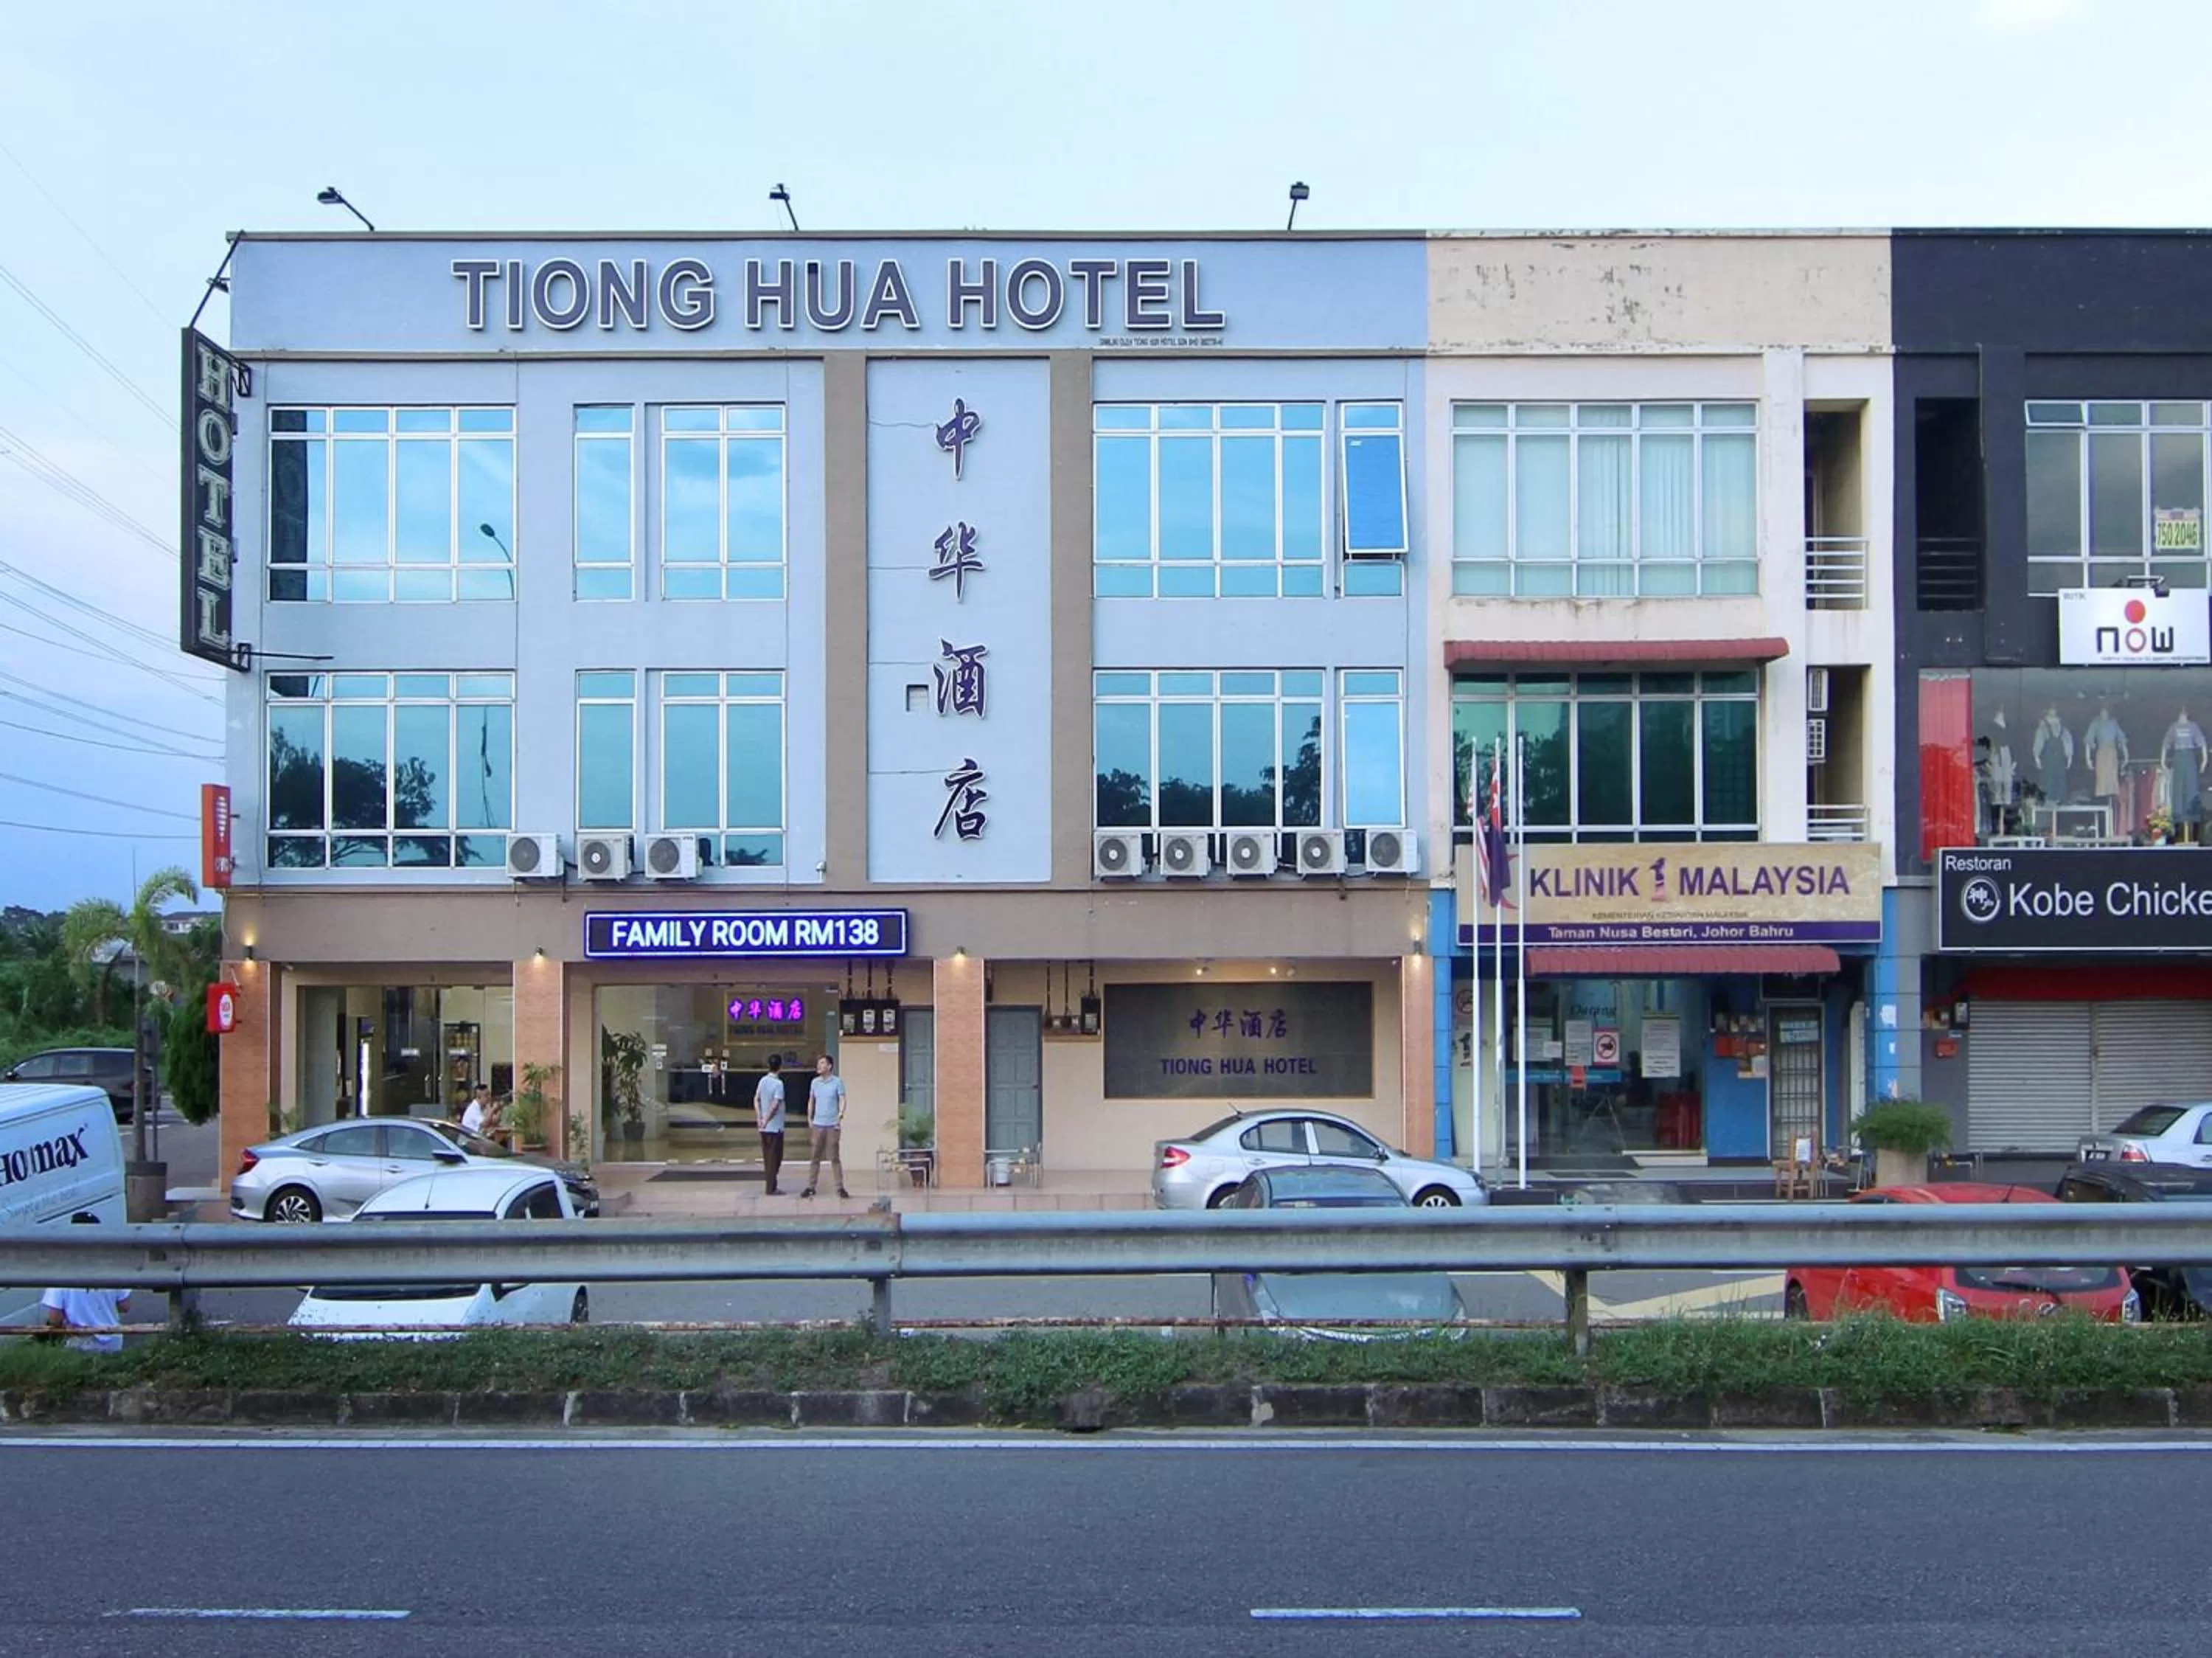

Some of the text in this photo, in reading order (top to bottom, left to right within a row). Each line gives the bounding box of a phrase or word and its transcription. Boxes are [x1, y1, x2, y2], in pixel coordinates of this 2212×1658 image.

[451, 257, 1226, 330] TIONG HUA HOTEL
[198, 341, 233, 650] HOTEL
[1944, 856, 2012, 871] Restoran
[1530, 867, 1640, 898] KLINIK
[1679, 865, 1850, 896] MALAYSIA
[2008, 881, 2212, 916] Kobe Chicke
[612, 919, 880, 947] FAMILY ROOM RM138
[1548, 926, 1595, 940] Taman
[1599, 926, 1638, 939] Nusa
[1702, 925, 1745, 938] Johor
[1749, 924, 1794, 937] Bahru
[1189, 1008, 1287, 1038] 中华酒店
[1161, 1057, 1318, 1075] TIONG HUA HOTEL
